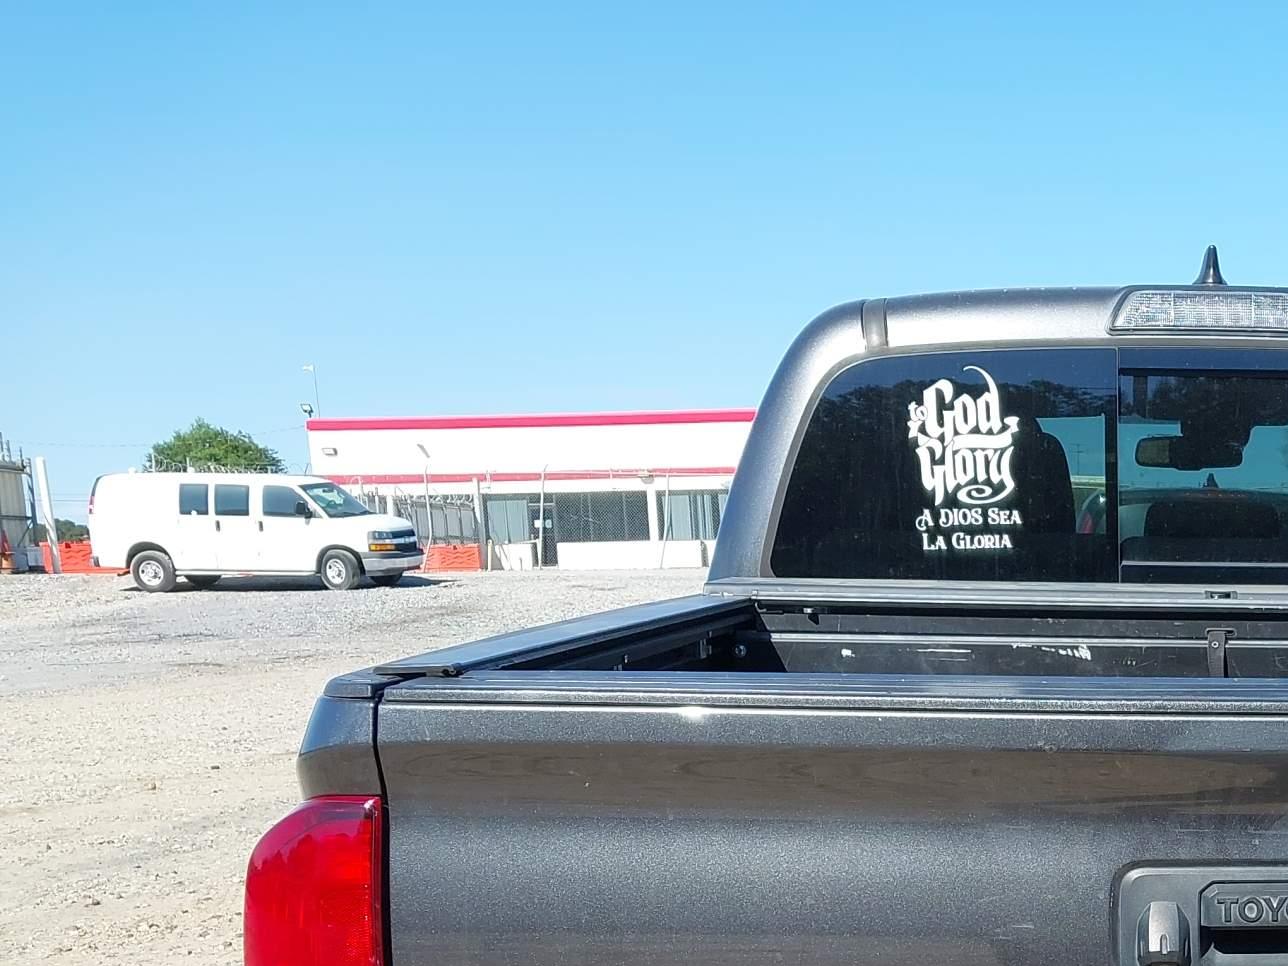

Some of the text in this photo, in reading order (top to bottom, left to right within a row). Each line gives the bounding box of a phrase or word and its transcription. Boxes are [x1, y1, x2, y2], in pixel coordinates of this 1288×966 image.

[908, 366, 1002, 447] to God
[915, 441, 1016, 506] Glory
[916, 509, 934, 531] A
[939, 508, 984, 527] DIOS
